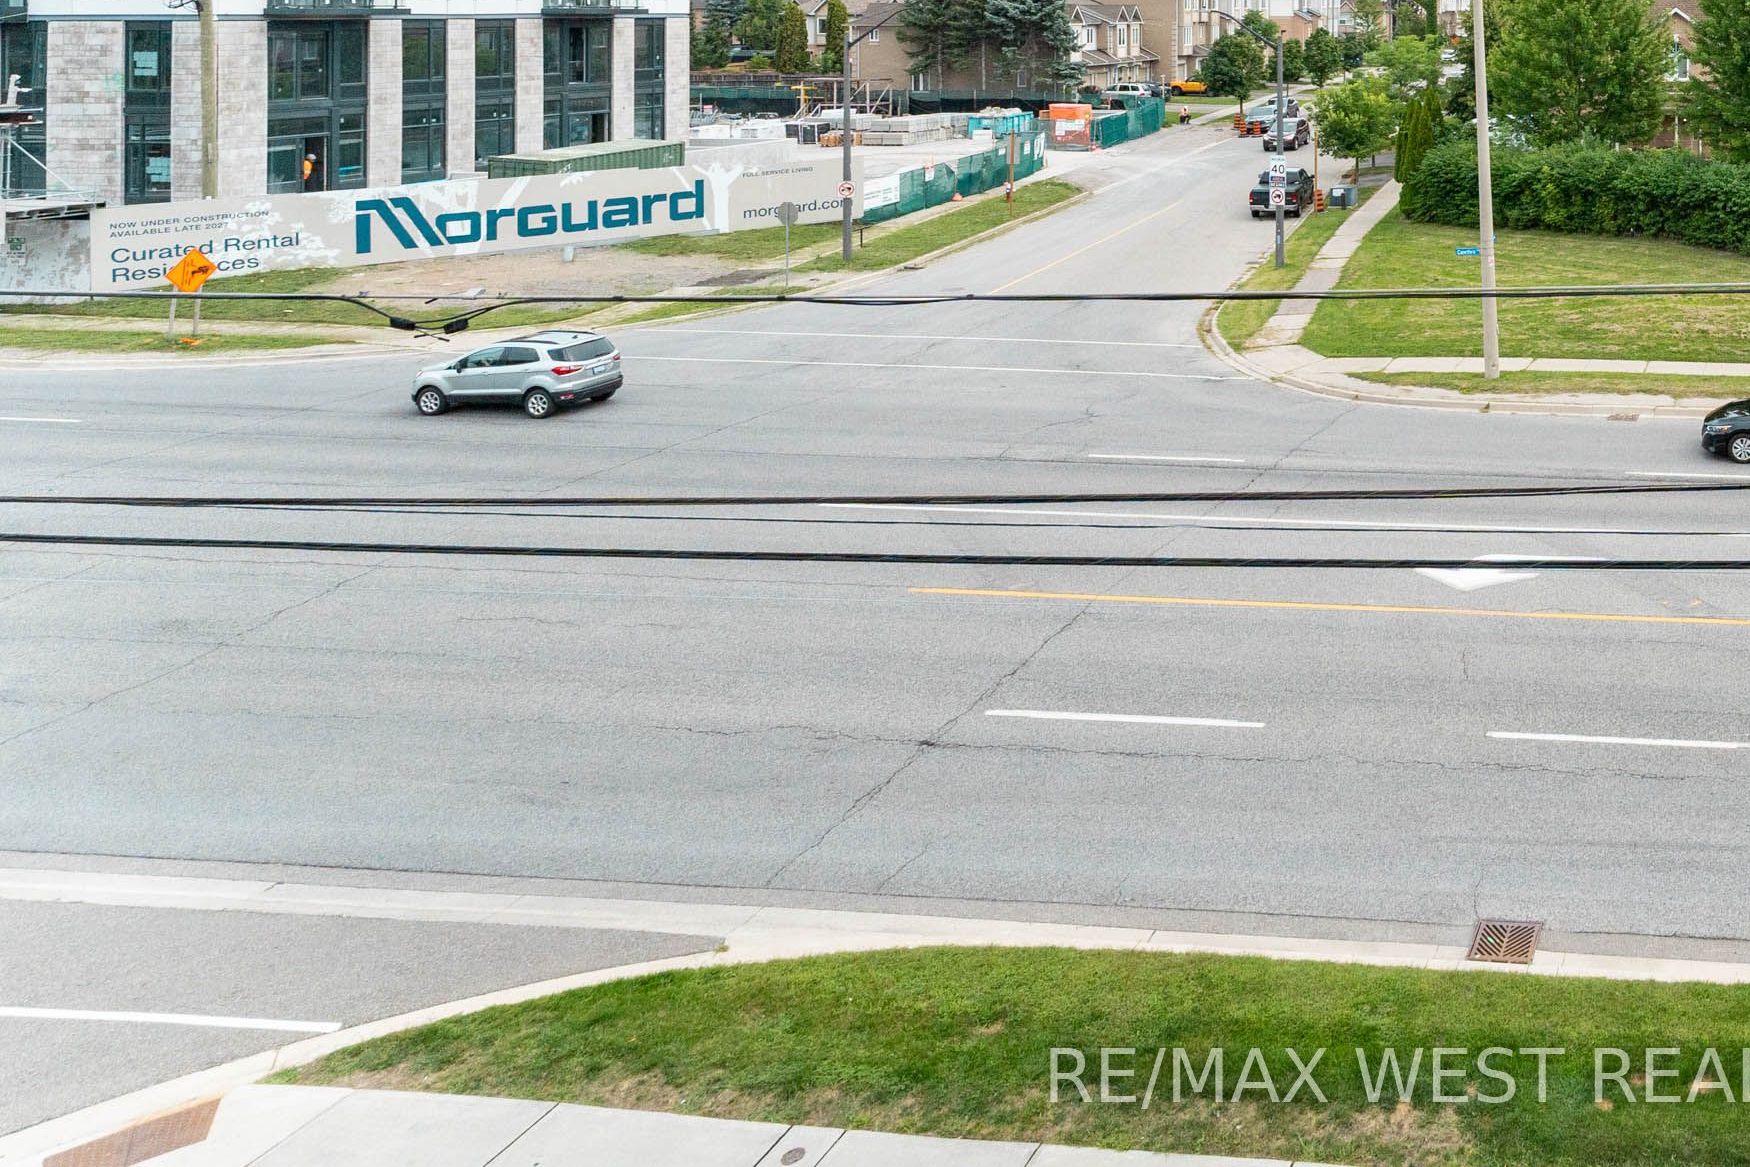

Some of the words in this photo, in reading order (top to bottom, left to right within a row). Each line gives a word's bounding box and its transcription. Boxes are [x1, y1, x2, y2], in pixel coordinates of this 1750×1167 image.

[1271, 164, 1285, 174] 40
[109, 221, 137, 229] NOW
[140, 217, 180, 227] UNDER
[183, 210, 269, 223] CONSTRUCTION
[109, 226, 172, 238] AVAILABLE
[174, 224, 202, 233] LATE
[111, 239, 214, 264] Curated
[224, 232, 300, 253] Rental
[112, 256, 260, 282] Resices
